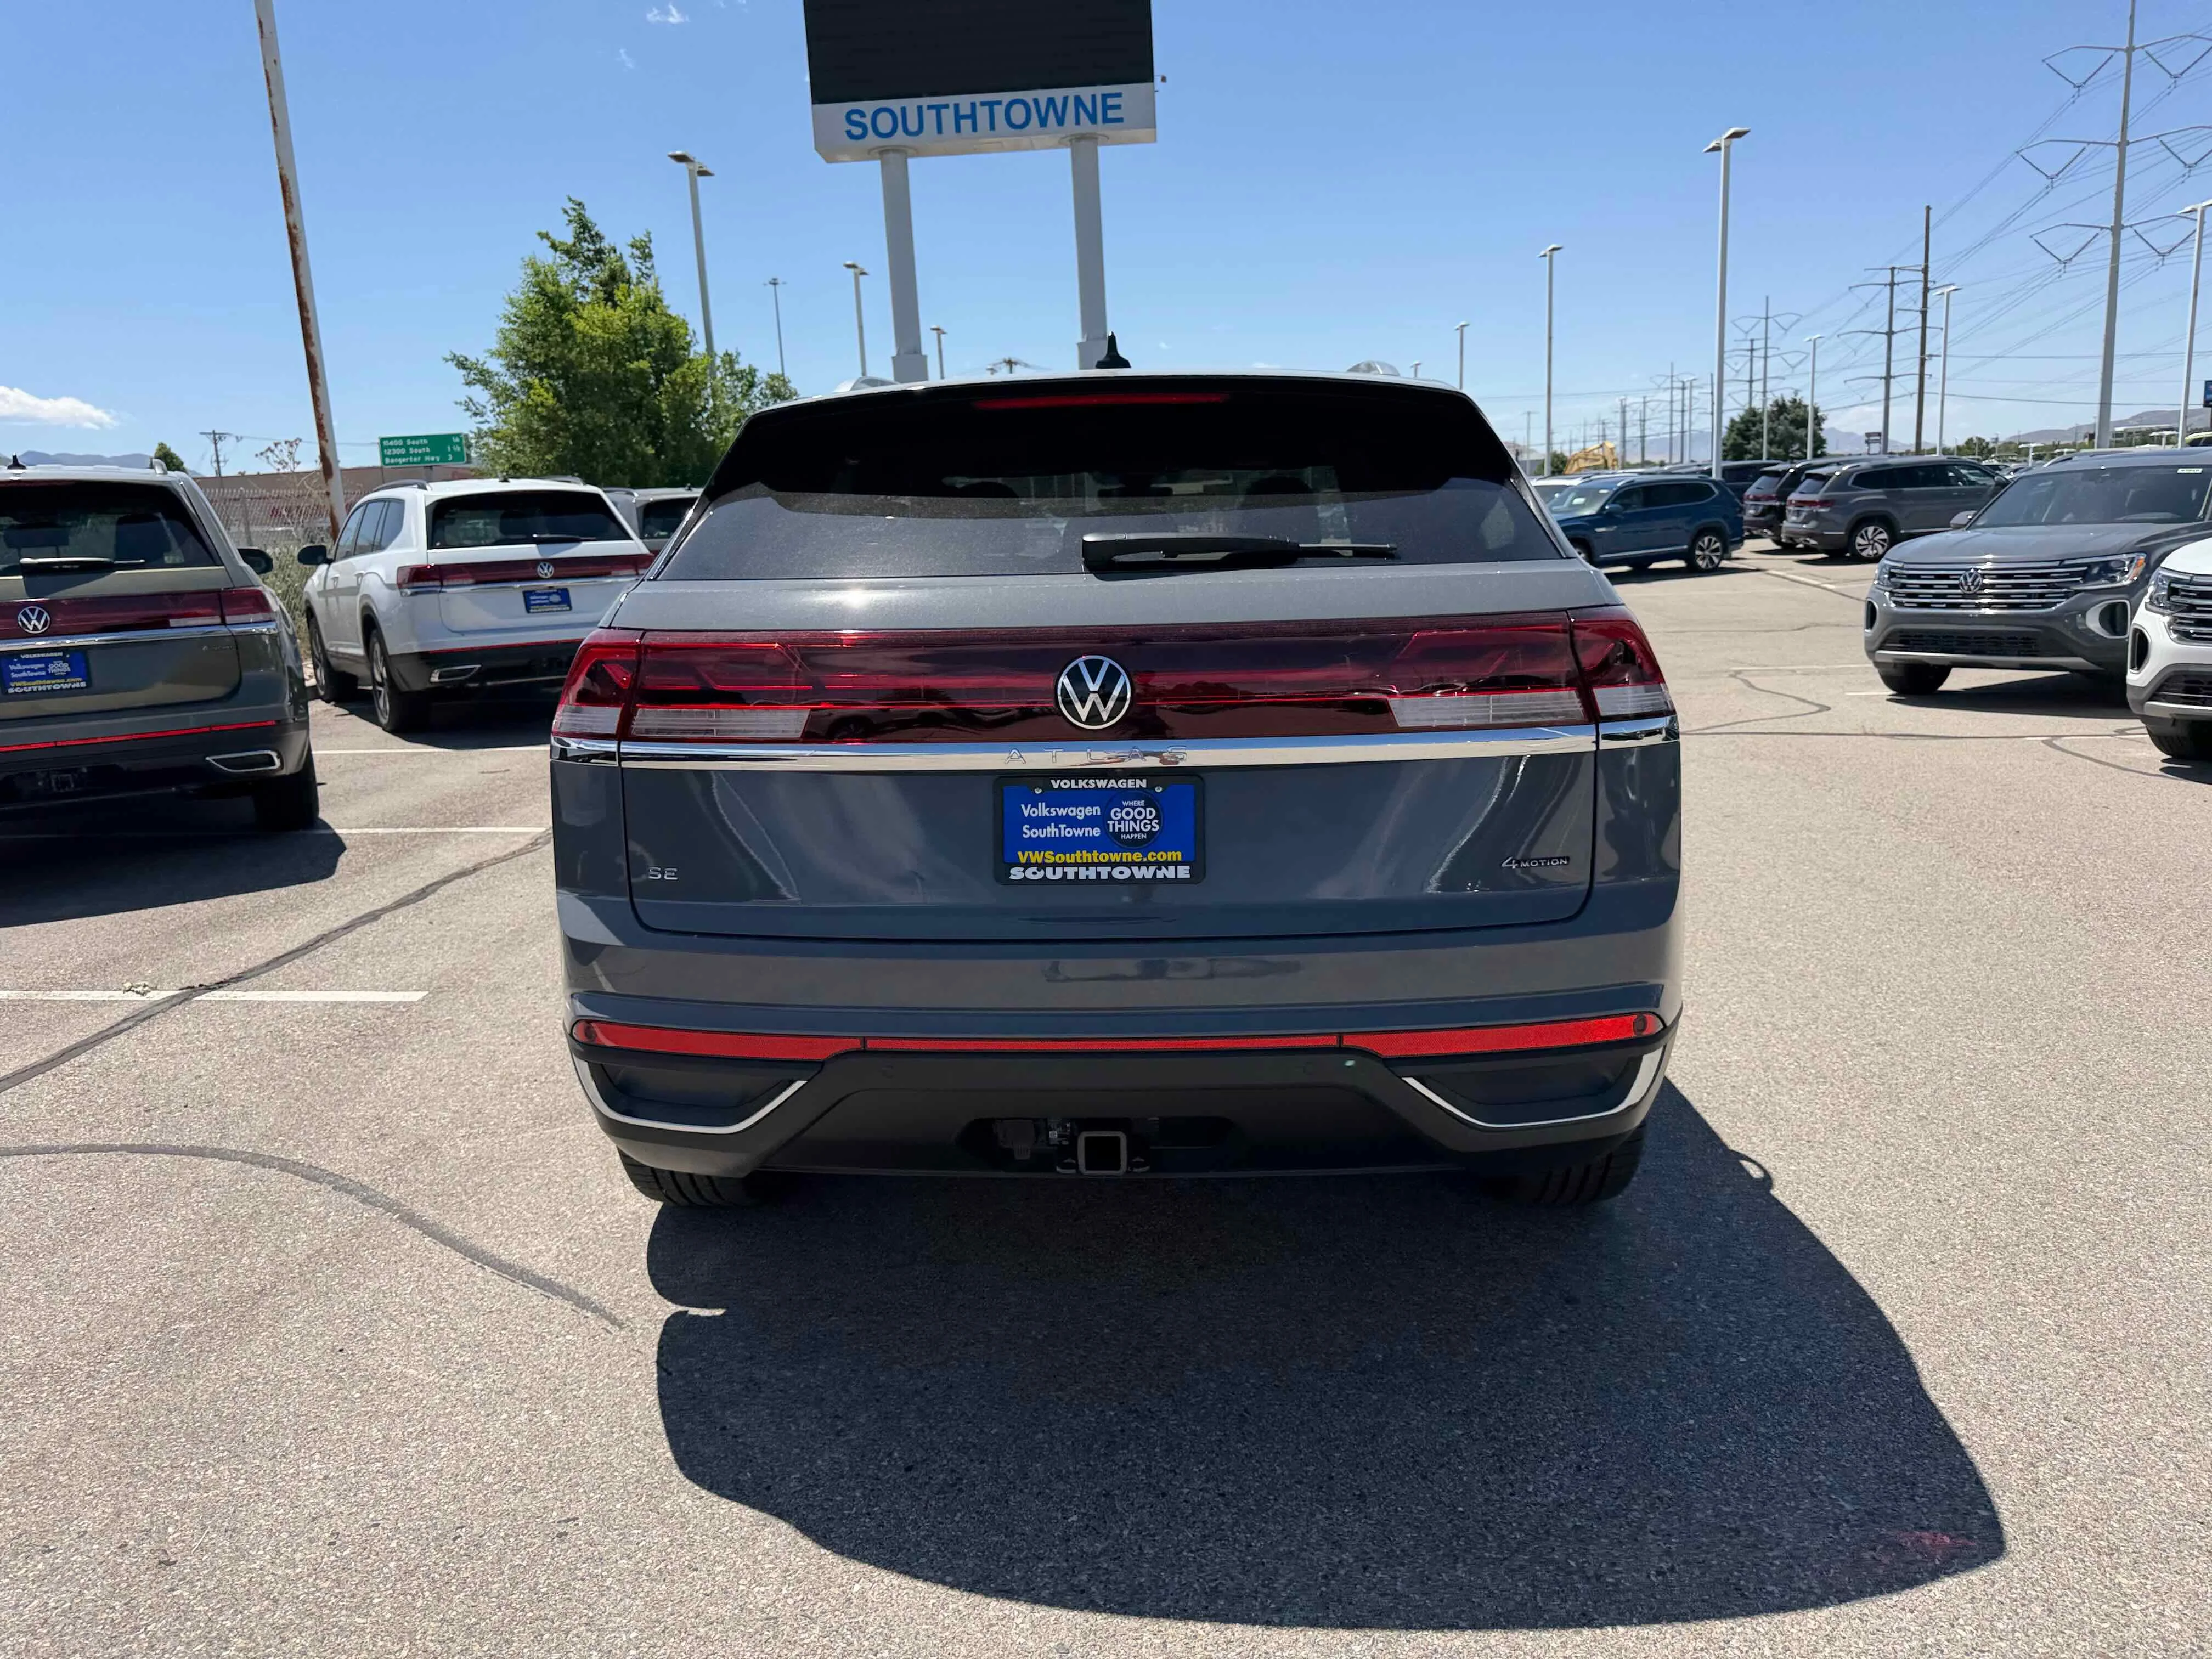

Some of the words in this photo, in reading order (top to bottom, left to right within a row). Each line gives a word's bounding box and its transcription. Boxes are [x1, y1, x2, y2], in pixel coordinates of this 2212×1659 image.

[844, 92, 1125, 141] SOUTHTOWNE
[385, 456, 421, 464] Bangerter
[8, 681, 87, 693] SOUTHTOWNE
[1005, 745, 1188, 764] ATLAS
[1051, 778, 1147, 789] VOLKSWAGEN
[1021, 803, 1101, 820] Volkswagen
[1110, 807, 1156, 820] GOOD
[1022, 824, 1101, 838] SouthTowne
[1107, 820, 1159, 832] THINGS
[1018, 850, 1182, 864] VWSouthtowne.com
[648, 867, 678, 880] SE
[1009, 865, 1190, 880] SOUTHTOWNE
